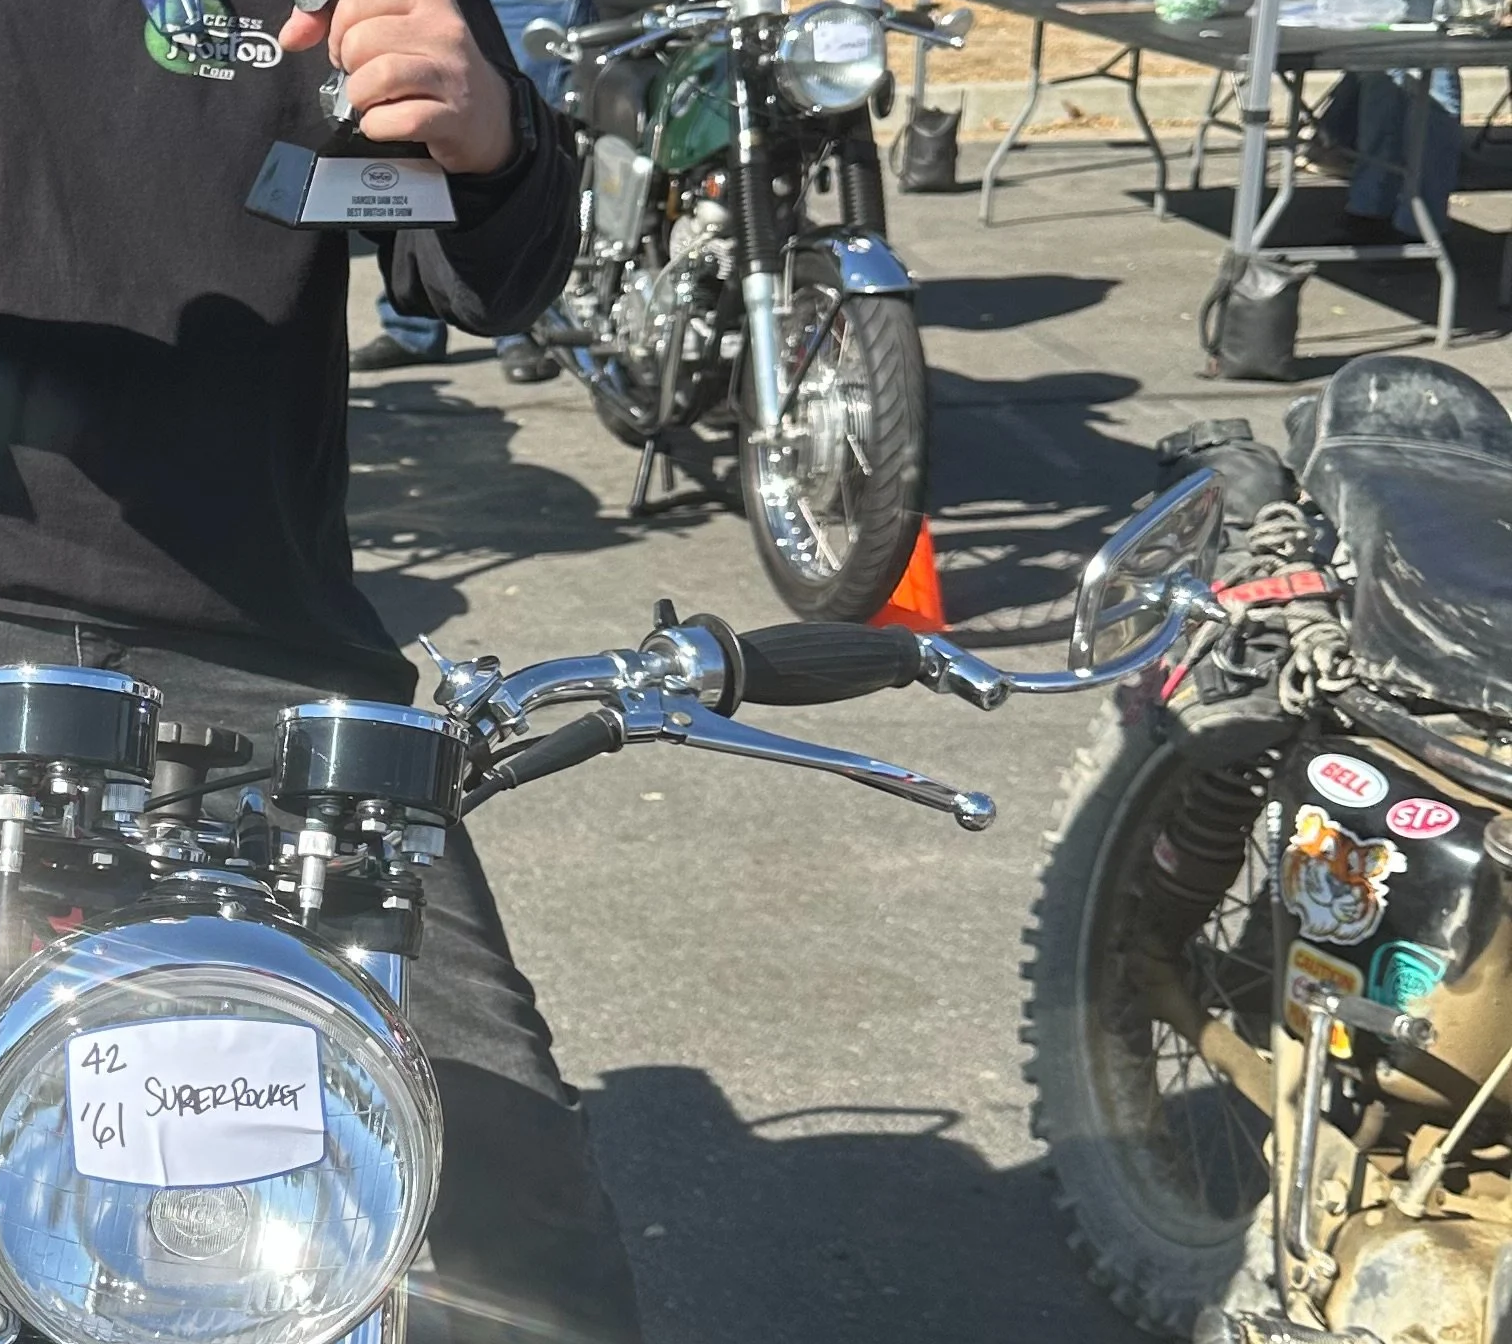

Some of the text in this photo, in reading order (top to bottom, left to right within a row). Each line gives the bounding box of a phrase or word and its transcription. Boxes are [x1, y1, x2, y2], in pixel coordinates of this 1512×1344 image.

[202, 13, 264, 30] CCESS
[166, 30, 283, 68] Norton
[1320, 761, 1372, 797] BELL
[1394, 804, 1450, 829] STP
[81, 1042, 127, 1075] 42
[80, 1102, 126, 1149] '61
